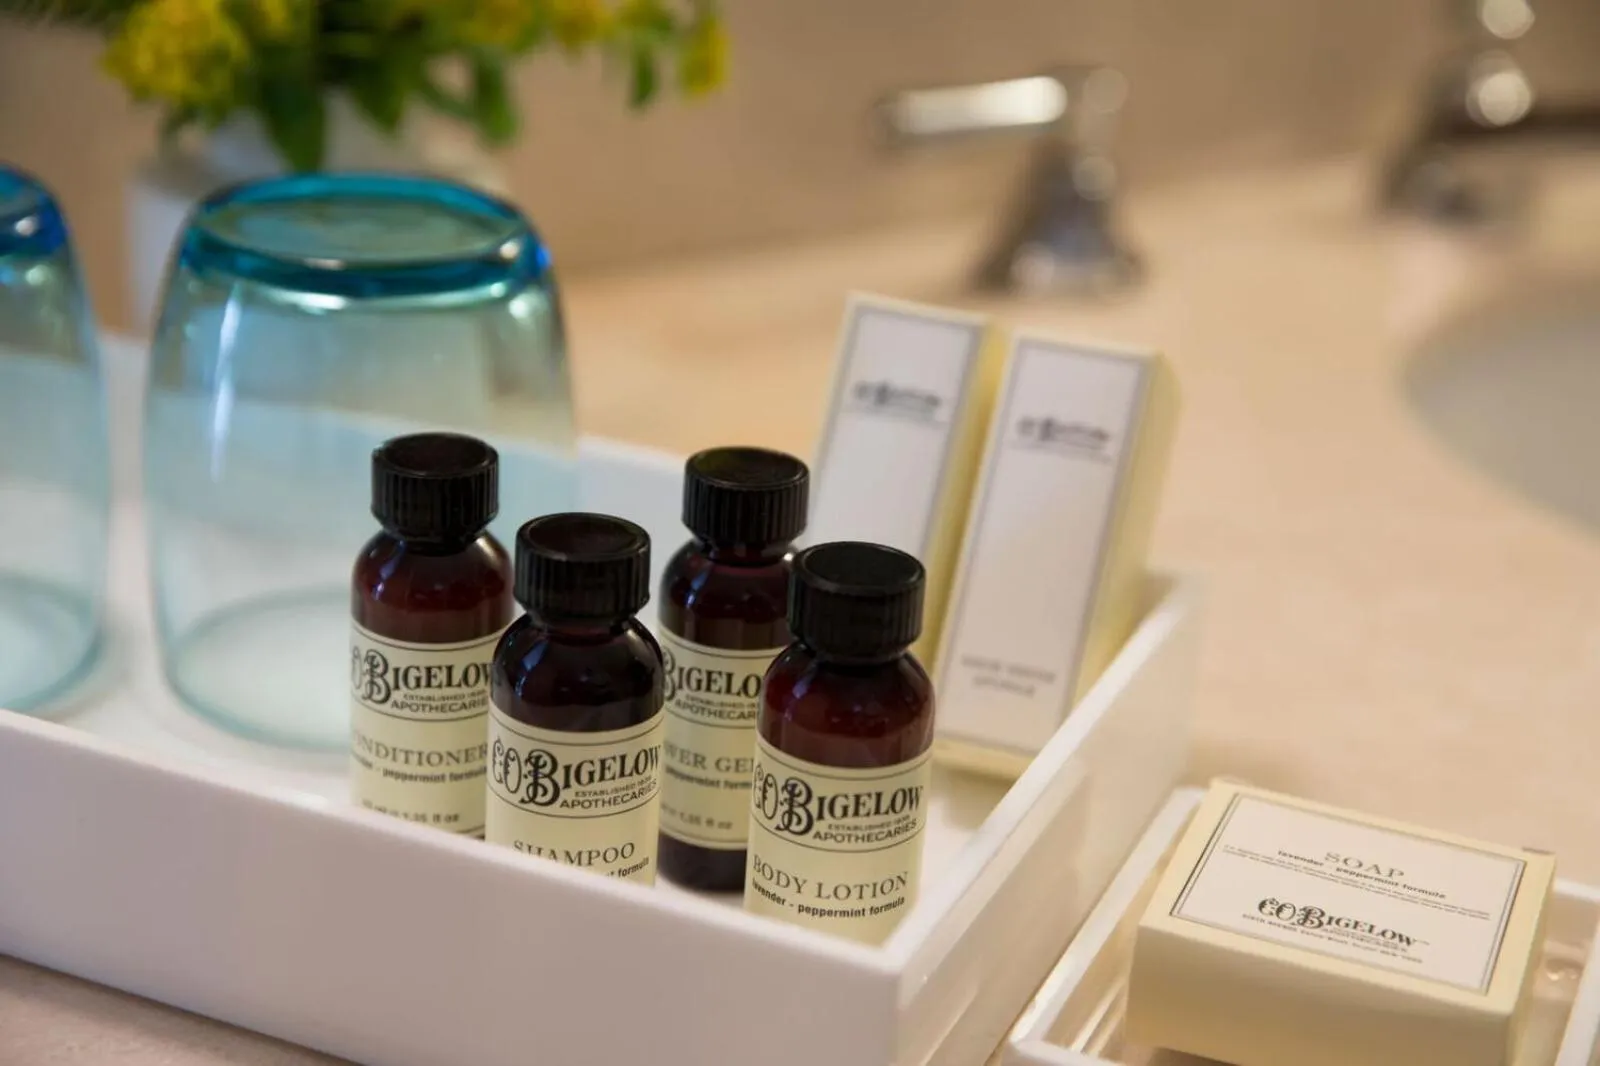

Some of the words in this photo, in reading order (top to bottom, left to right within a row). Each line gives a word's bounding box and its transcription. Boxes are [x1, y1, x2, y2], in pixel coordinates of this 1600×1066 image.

[753, 853, 808, 895] BODY
[814, 870, 909, 901] LOTION
[1324, 851, 1405, 878] SOAP
[1335, 865, 1401, 887] peppermint
[1402, 883, 1447, 899] formula
[797, 903, 867, 918] peppermint
